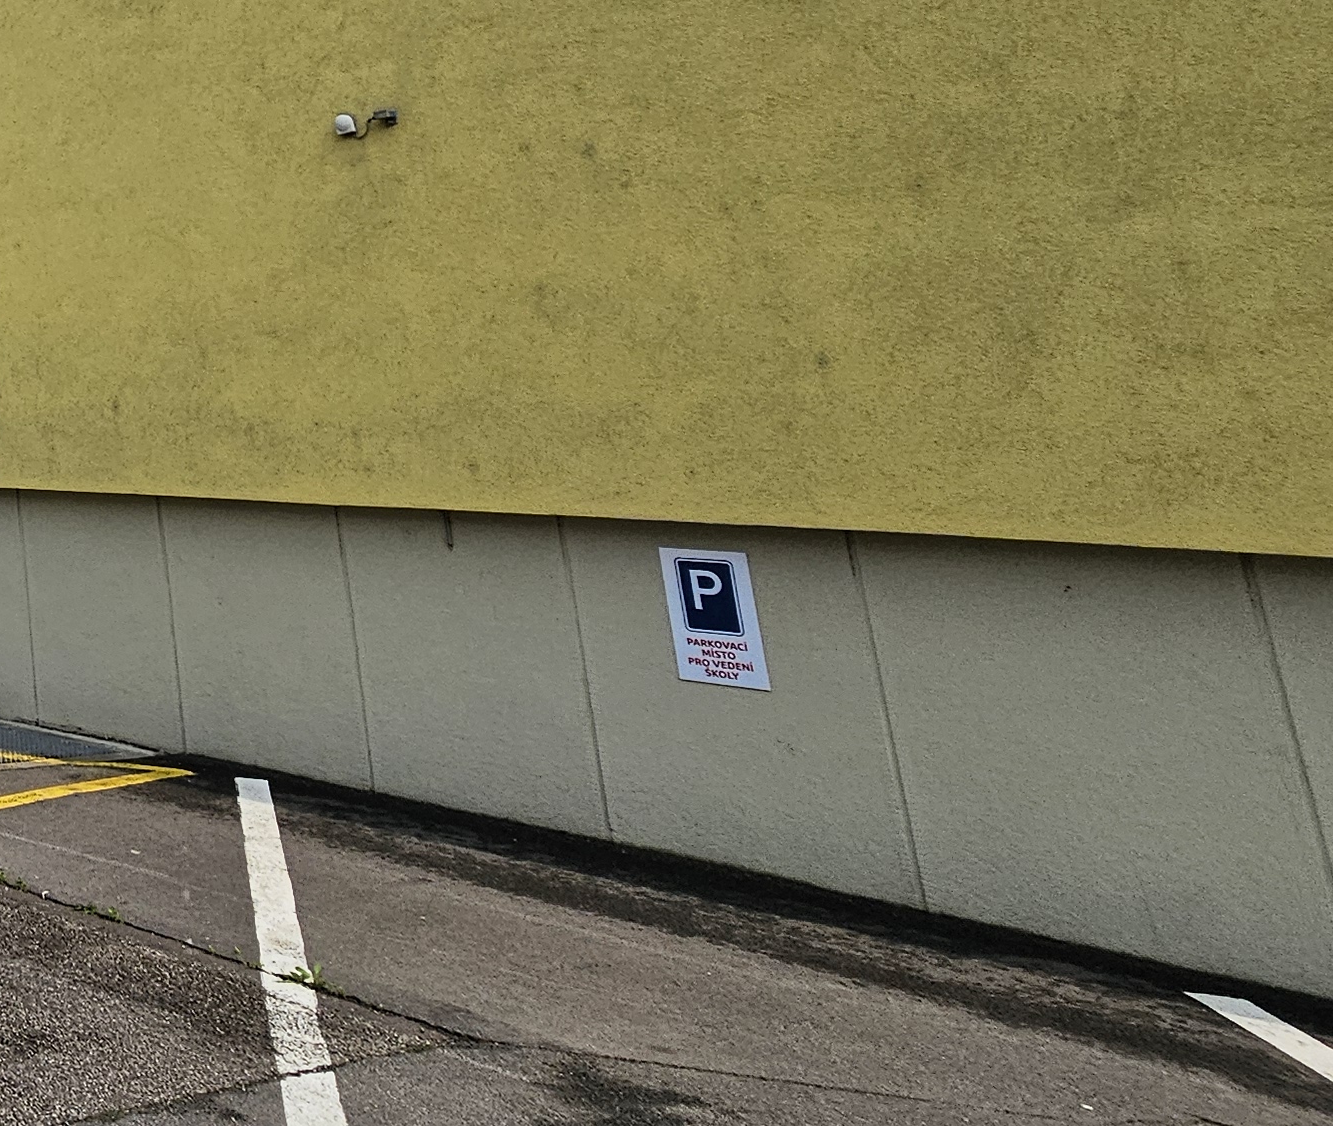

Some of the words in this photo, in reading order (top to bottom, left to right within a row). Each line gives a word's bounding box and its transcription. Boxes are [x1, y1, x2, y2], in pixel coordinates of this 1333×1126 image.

[688, 569, 723, 610] P
[686, 638, 748, 652] PARKOVACÍ
[701, 648, 736, 660] MÍSTO
[688, 657, 710, 667] PRO
[712, 659, 754, 672] VEDENÍ
[704, 666, 739, 680] ŠKOLY
